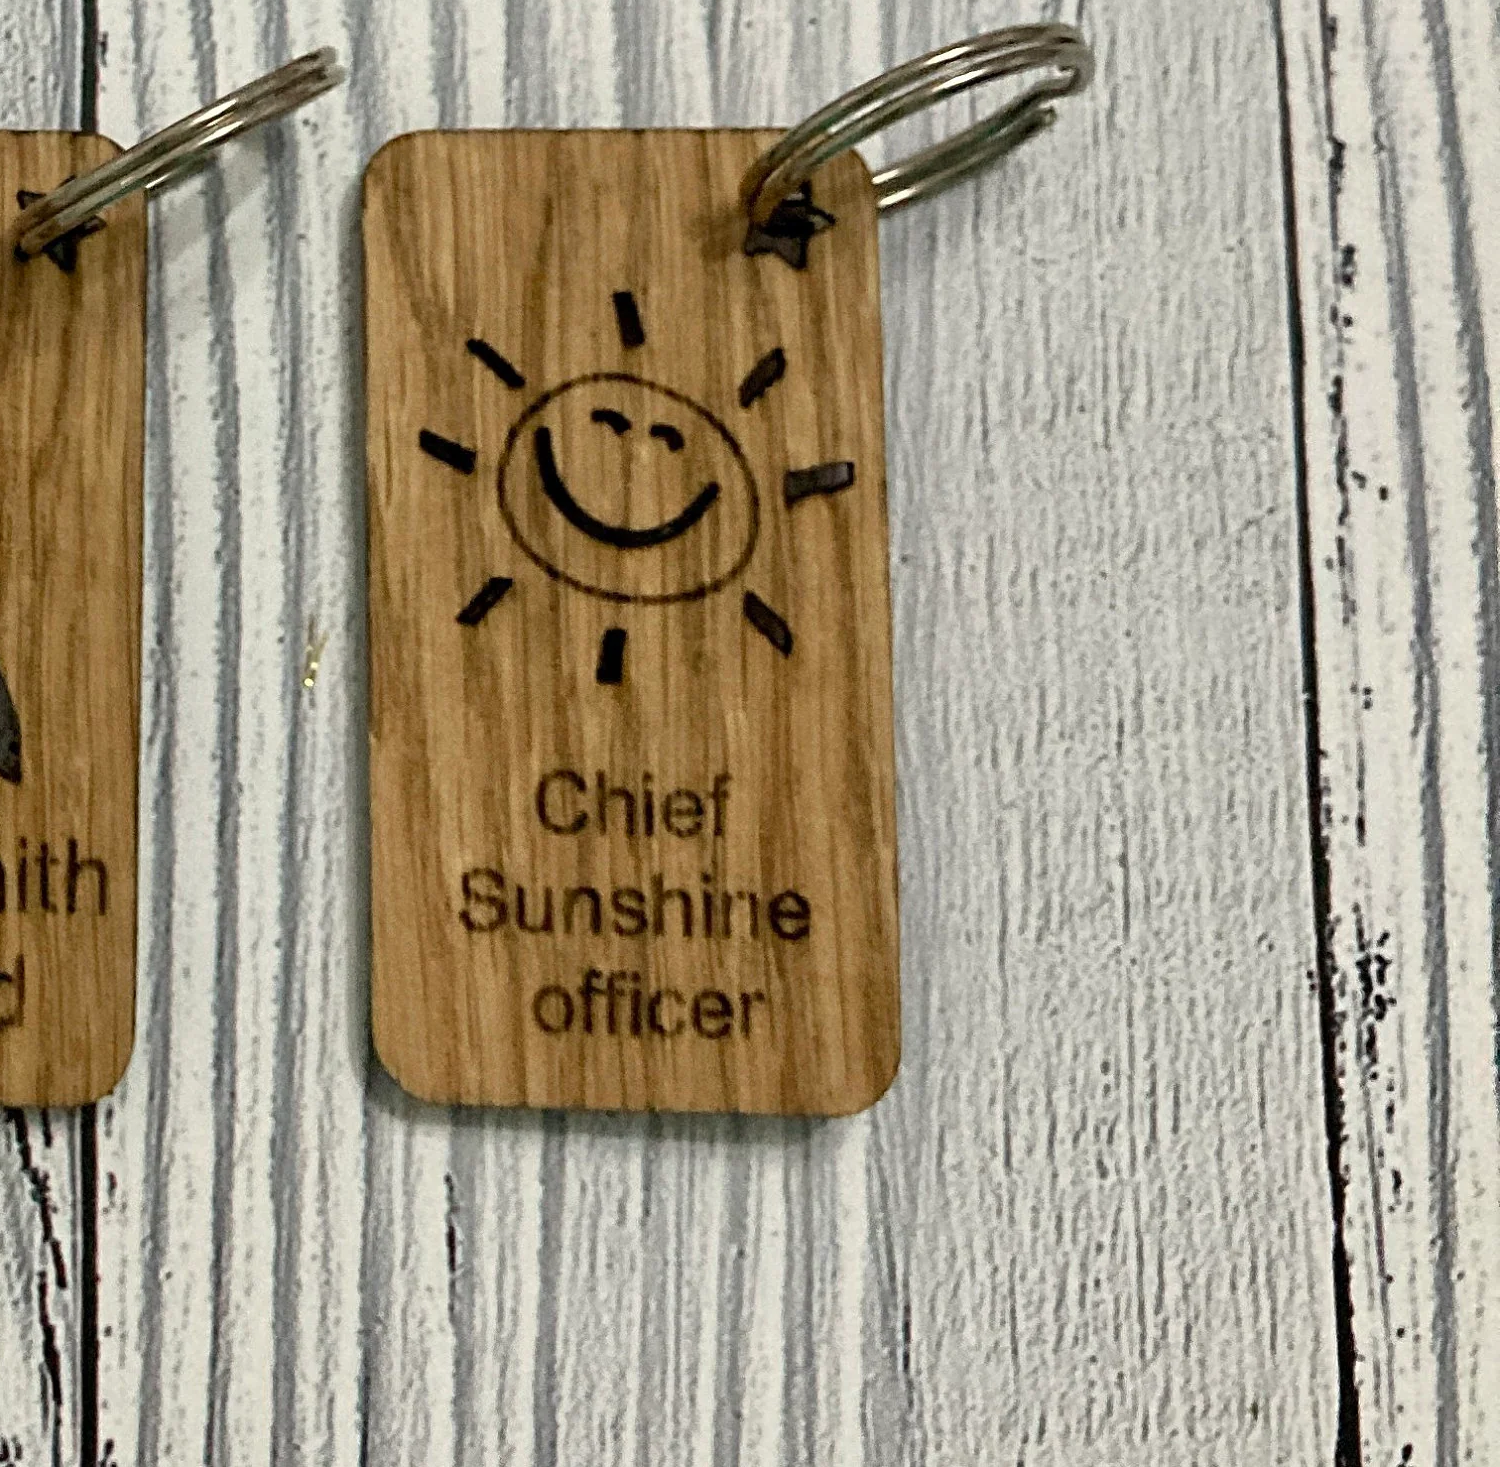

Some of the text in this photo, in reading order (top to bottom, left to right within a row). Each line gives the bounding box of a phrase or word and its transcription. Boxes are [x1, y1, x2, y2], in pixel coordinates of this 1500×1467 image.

[535, 769, 732, 836] Chief
[458, 867, 812, 941] Sunshine
[532, 968, 765, 1039] officer
